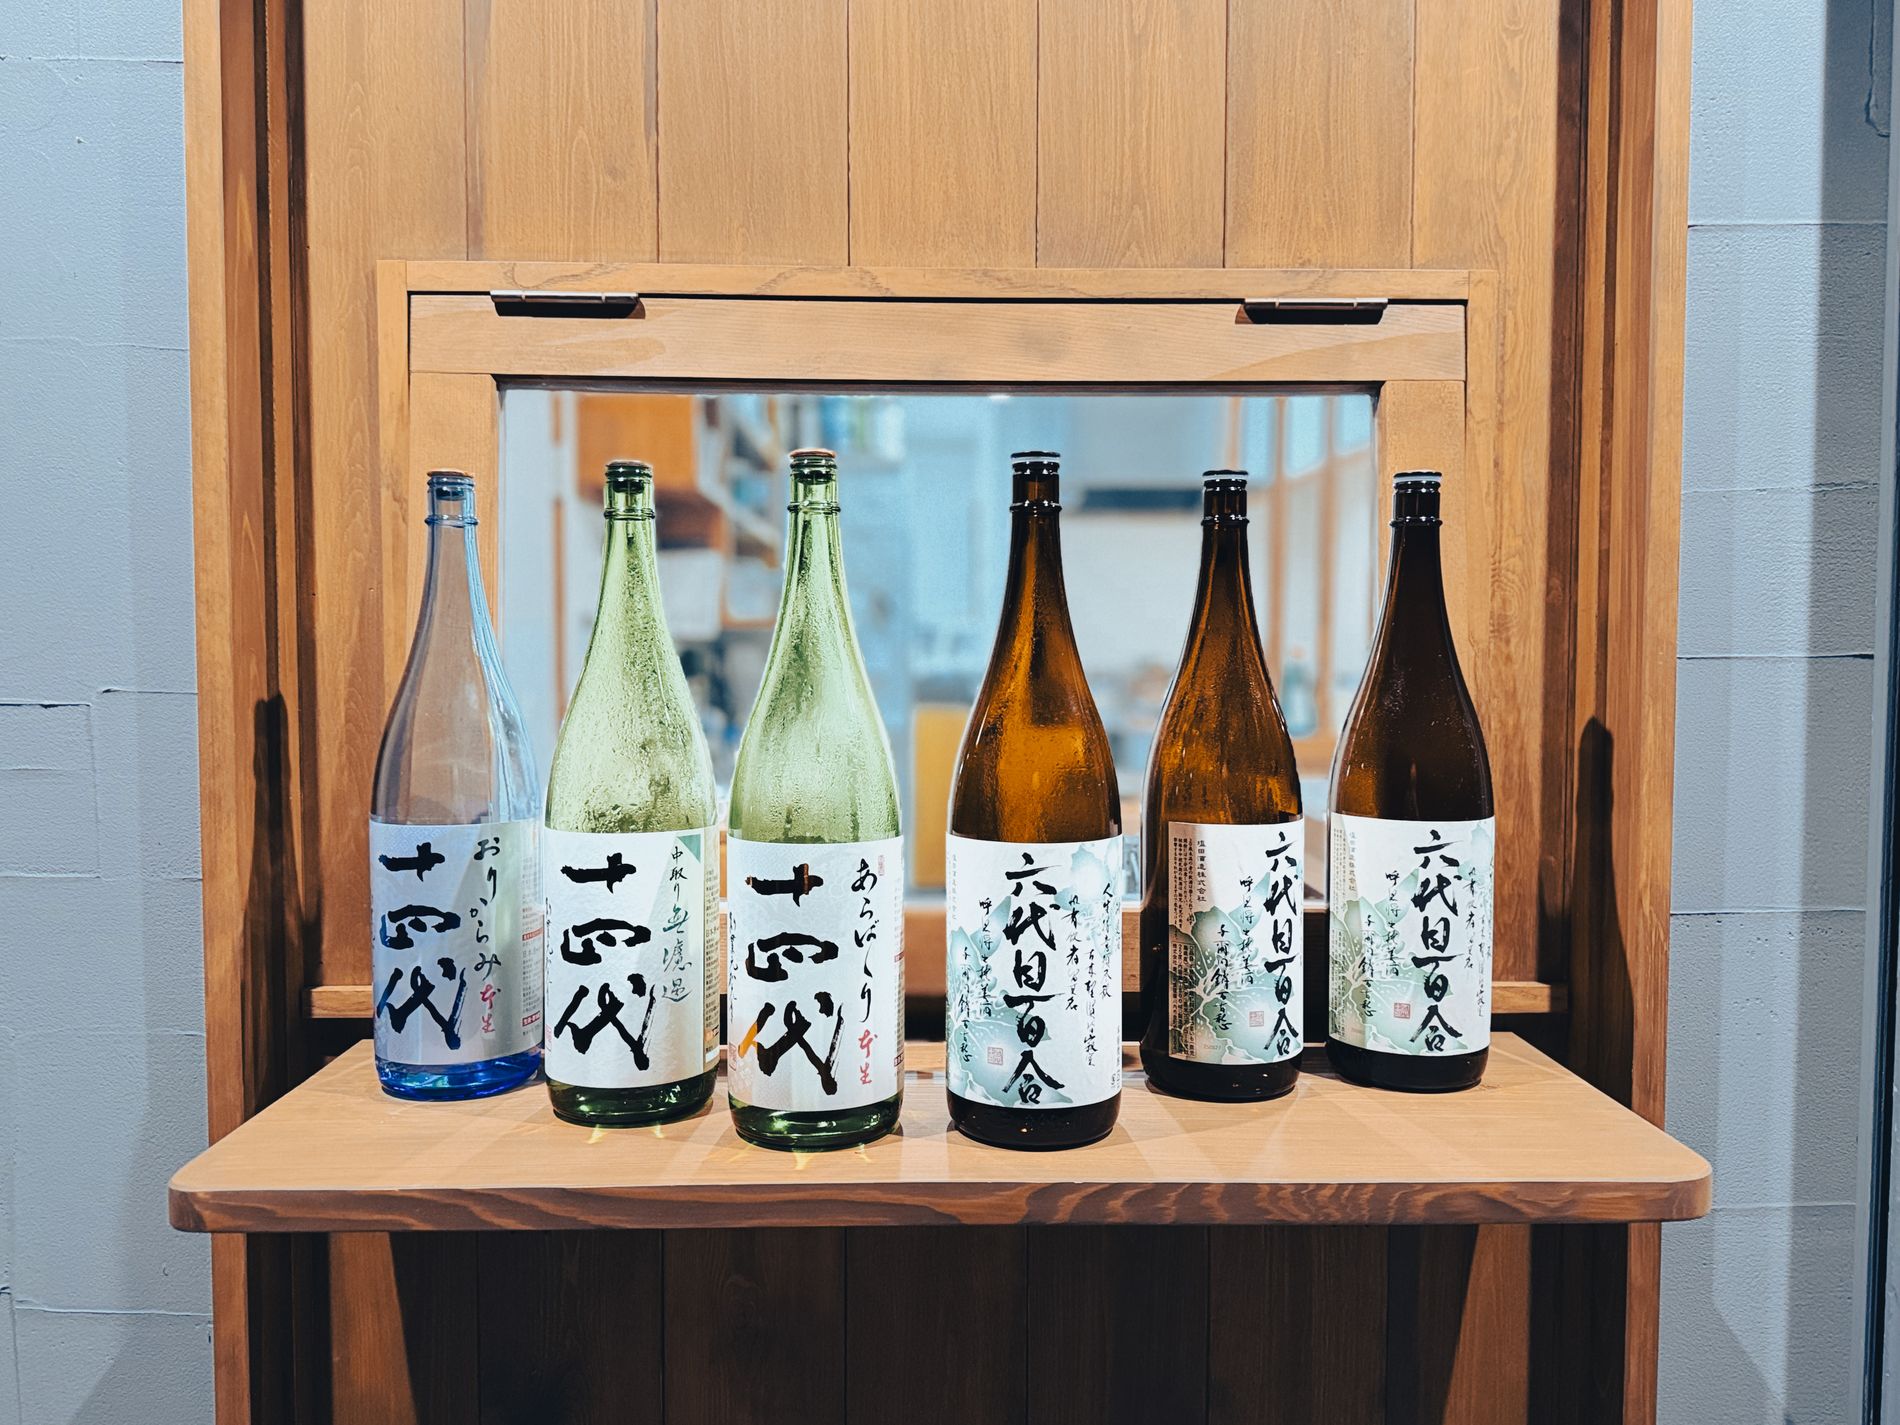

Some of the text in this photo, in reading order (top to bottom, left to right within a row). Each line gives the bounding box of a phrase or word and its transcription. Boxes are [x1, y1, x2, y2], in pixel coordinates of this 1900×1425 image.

[376, 842, 467, 1050] 十四代
[553, 852, 656, 1070] 十四代
[738, 863, 844, 1095] 十四代
[851, 857, 880, 1023] あらばしり
[1002, 852, 1065, 1104] 六代目百合
[1263, 831, 1300, 1056] 六代目百合
[1409, 829, 1465, 1052] 六代目百合
